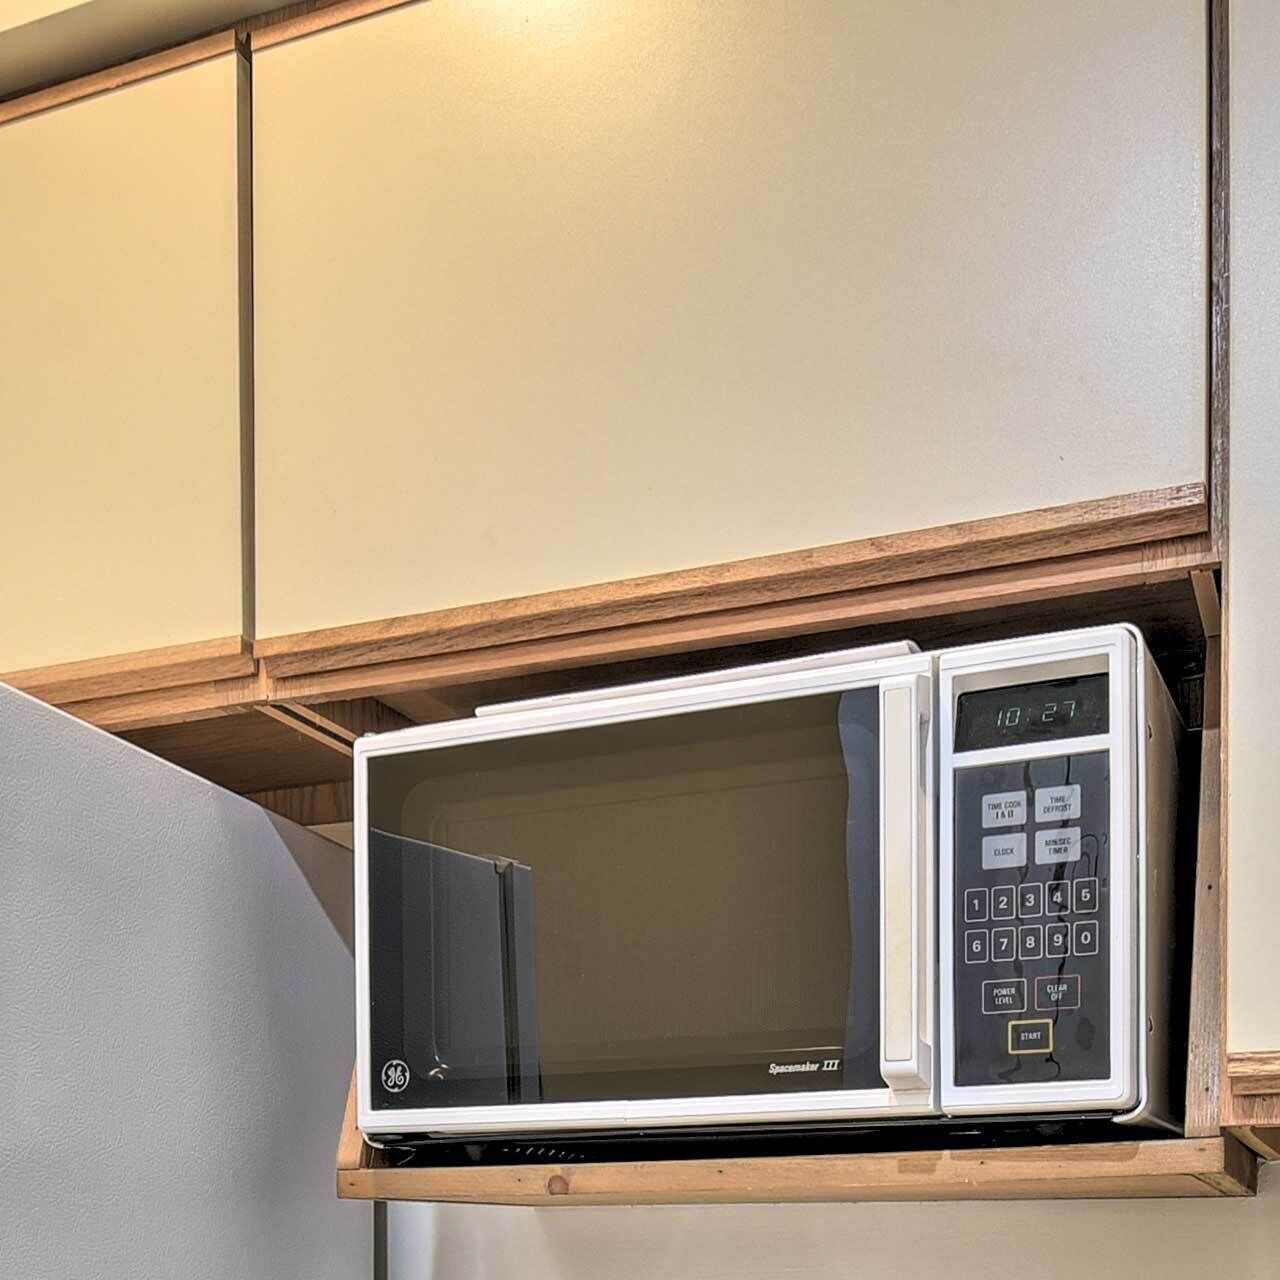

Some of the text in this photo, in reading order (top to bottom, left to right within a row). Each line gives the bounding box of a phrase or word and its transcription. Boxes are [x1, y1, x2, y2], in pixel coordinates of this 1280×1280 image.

[996, 700, 1076, 727] 10:27
[1050, 796, 1066, 804] TIME
[987, 800, 1022, 811] TIME COOK
[1043, 804, 1072, 814] DEFROST
[993, 847, 1015, 857] CLOCK
[1048, 847, 1069, 856] TIMER
[973, 888, 1090, 911] 1 2 3 4 5
[972, 931, 1091, 952] 6 7 8 9 0
[993, 987, 1016, 996] POWER
[1046, 983, 1068, 993] CLEAR
[994, 996, 1014, 1005] LEVEL
[1020, 1031, 1041, 1041] START
[768, 1059, 840, 1075] Spacemaker III
